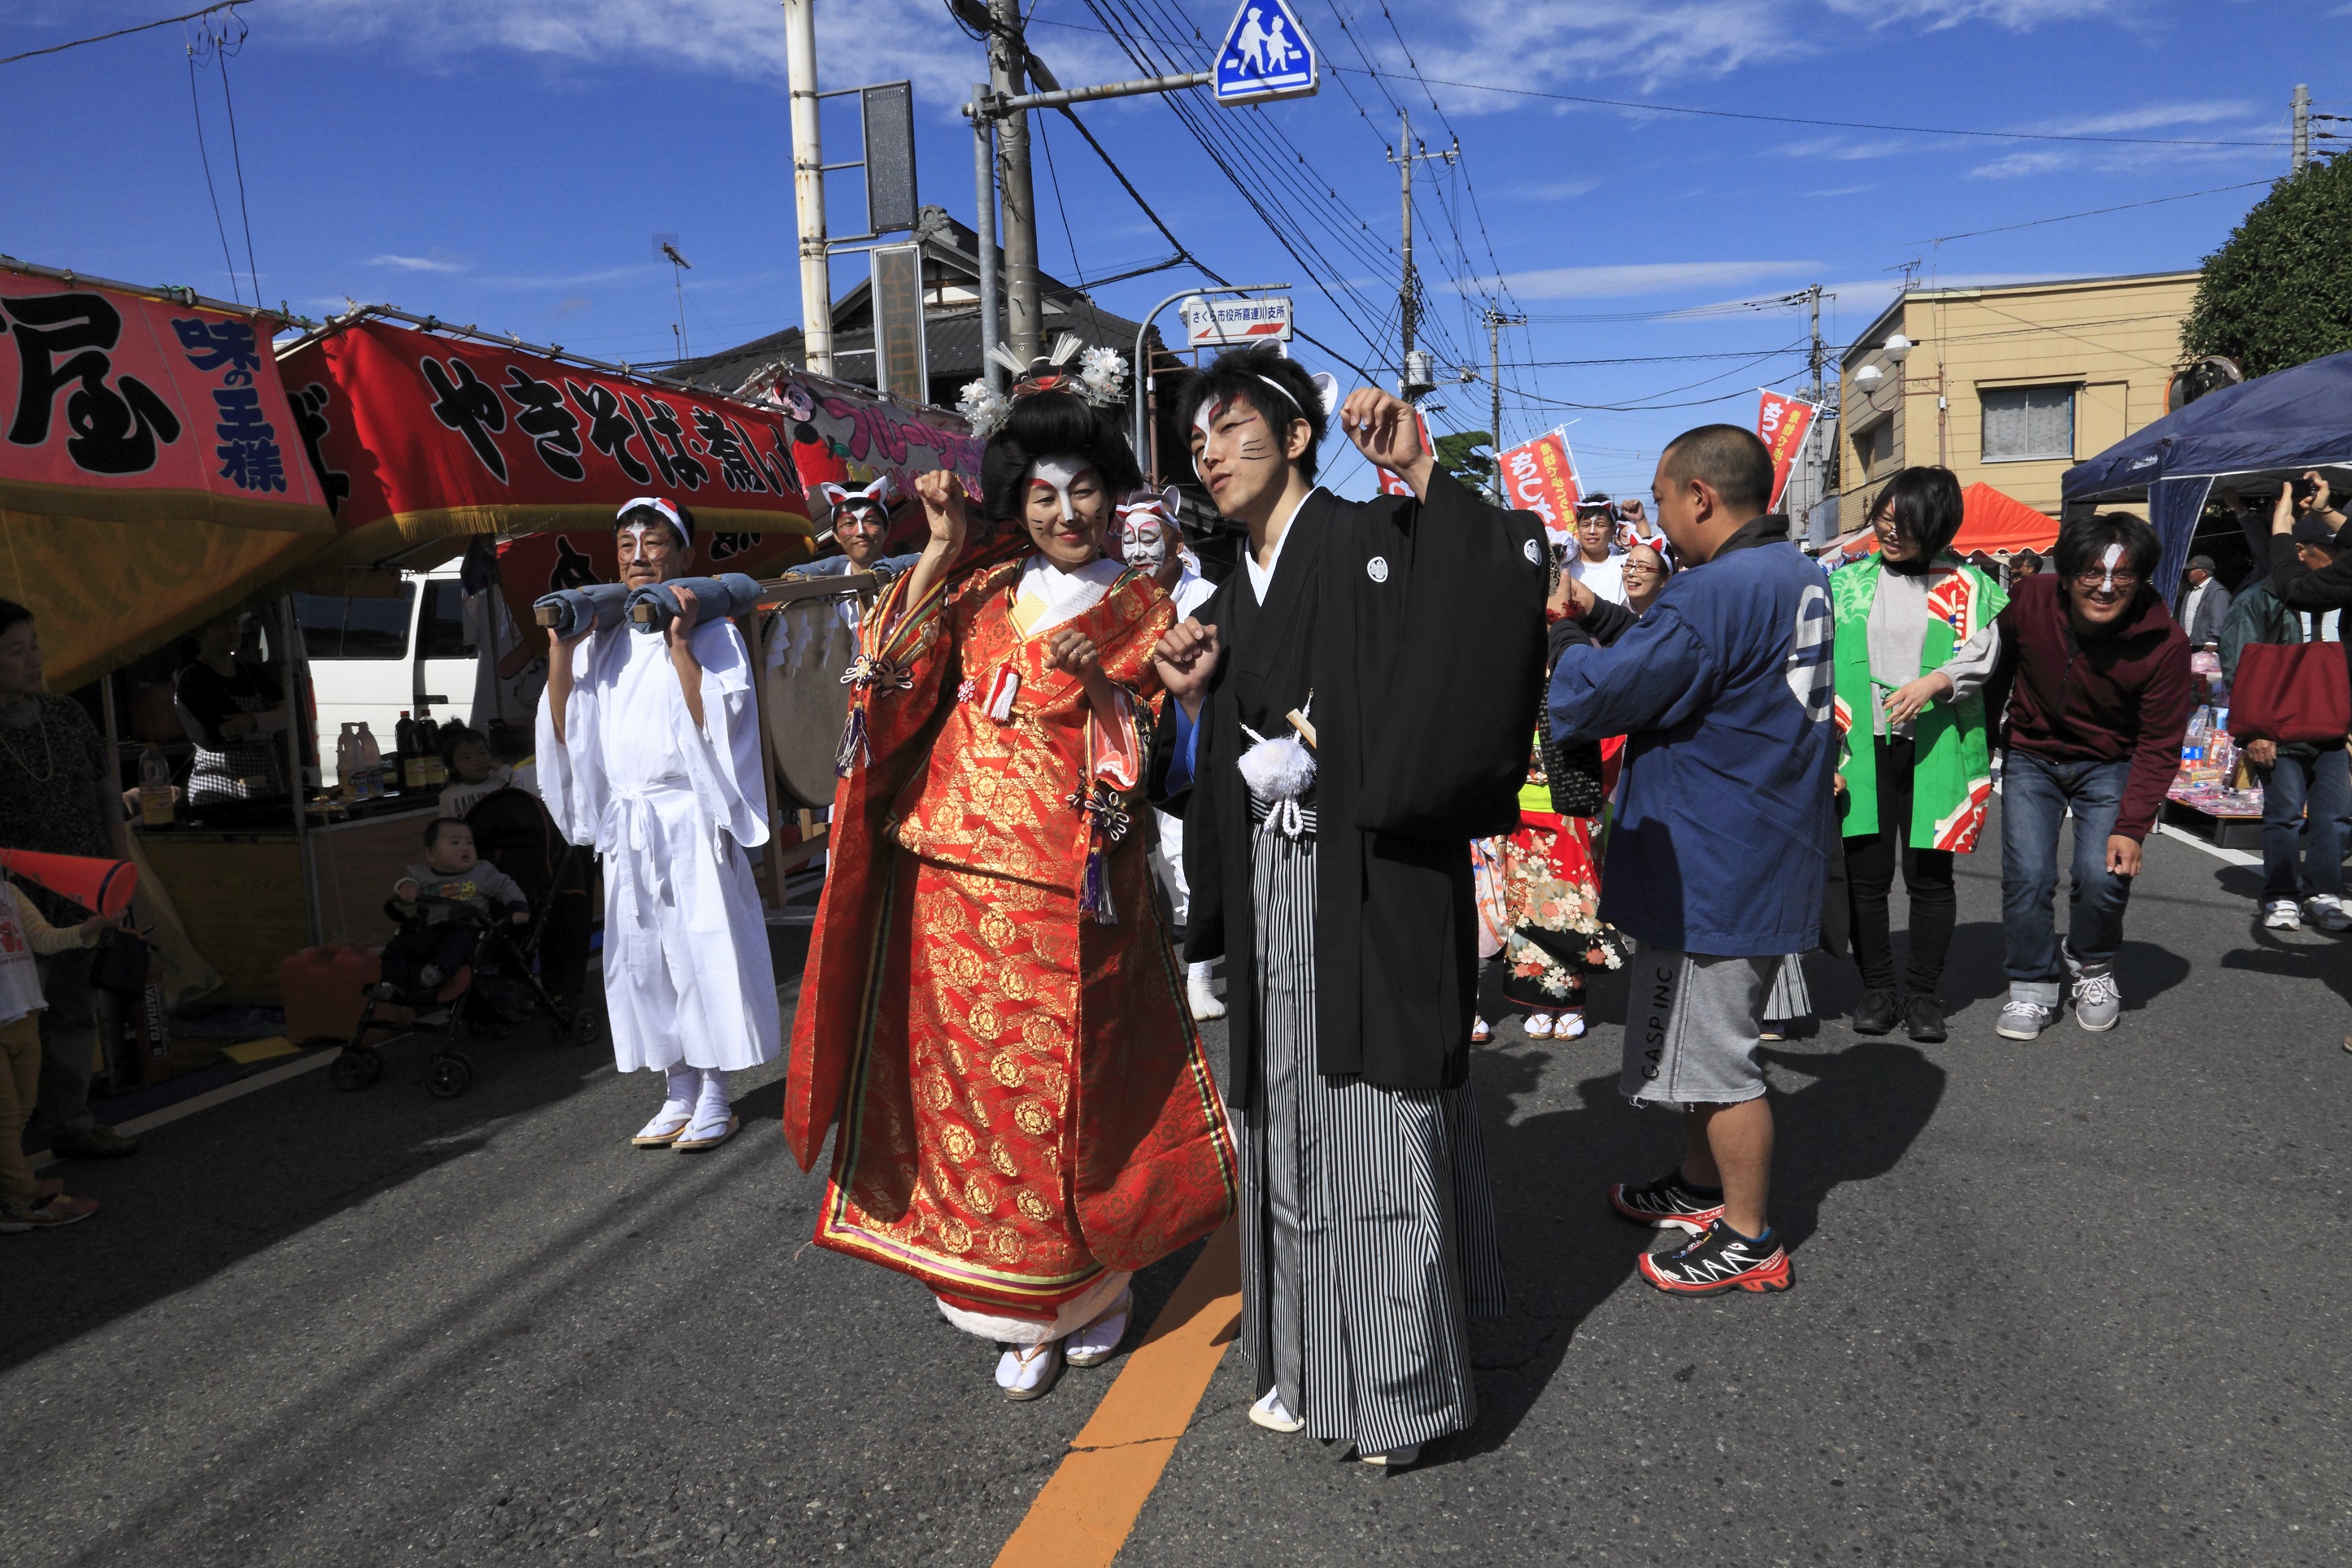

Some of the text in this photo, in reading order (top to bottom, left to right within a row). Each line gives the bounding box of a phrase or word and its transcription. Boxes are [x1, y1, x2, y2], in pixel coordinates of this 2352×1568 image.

[1193, 306, 1284, 324] さくら市役所喜連川支所
[171, 318, 287, 493] 味の王様
[1641, 966, 1673, 1082] GASP INC
